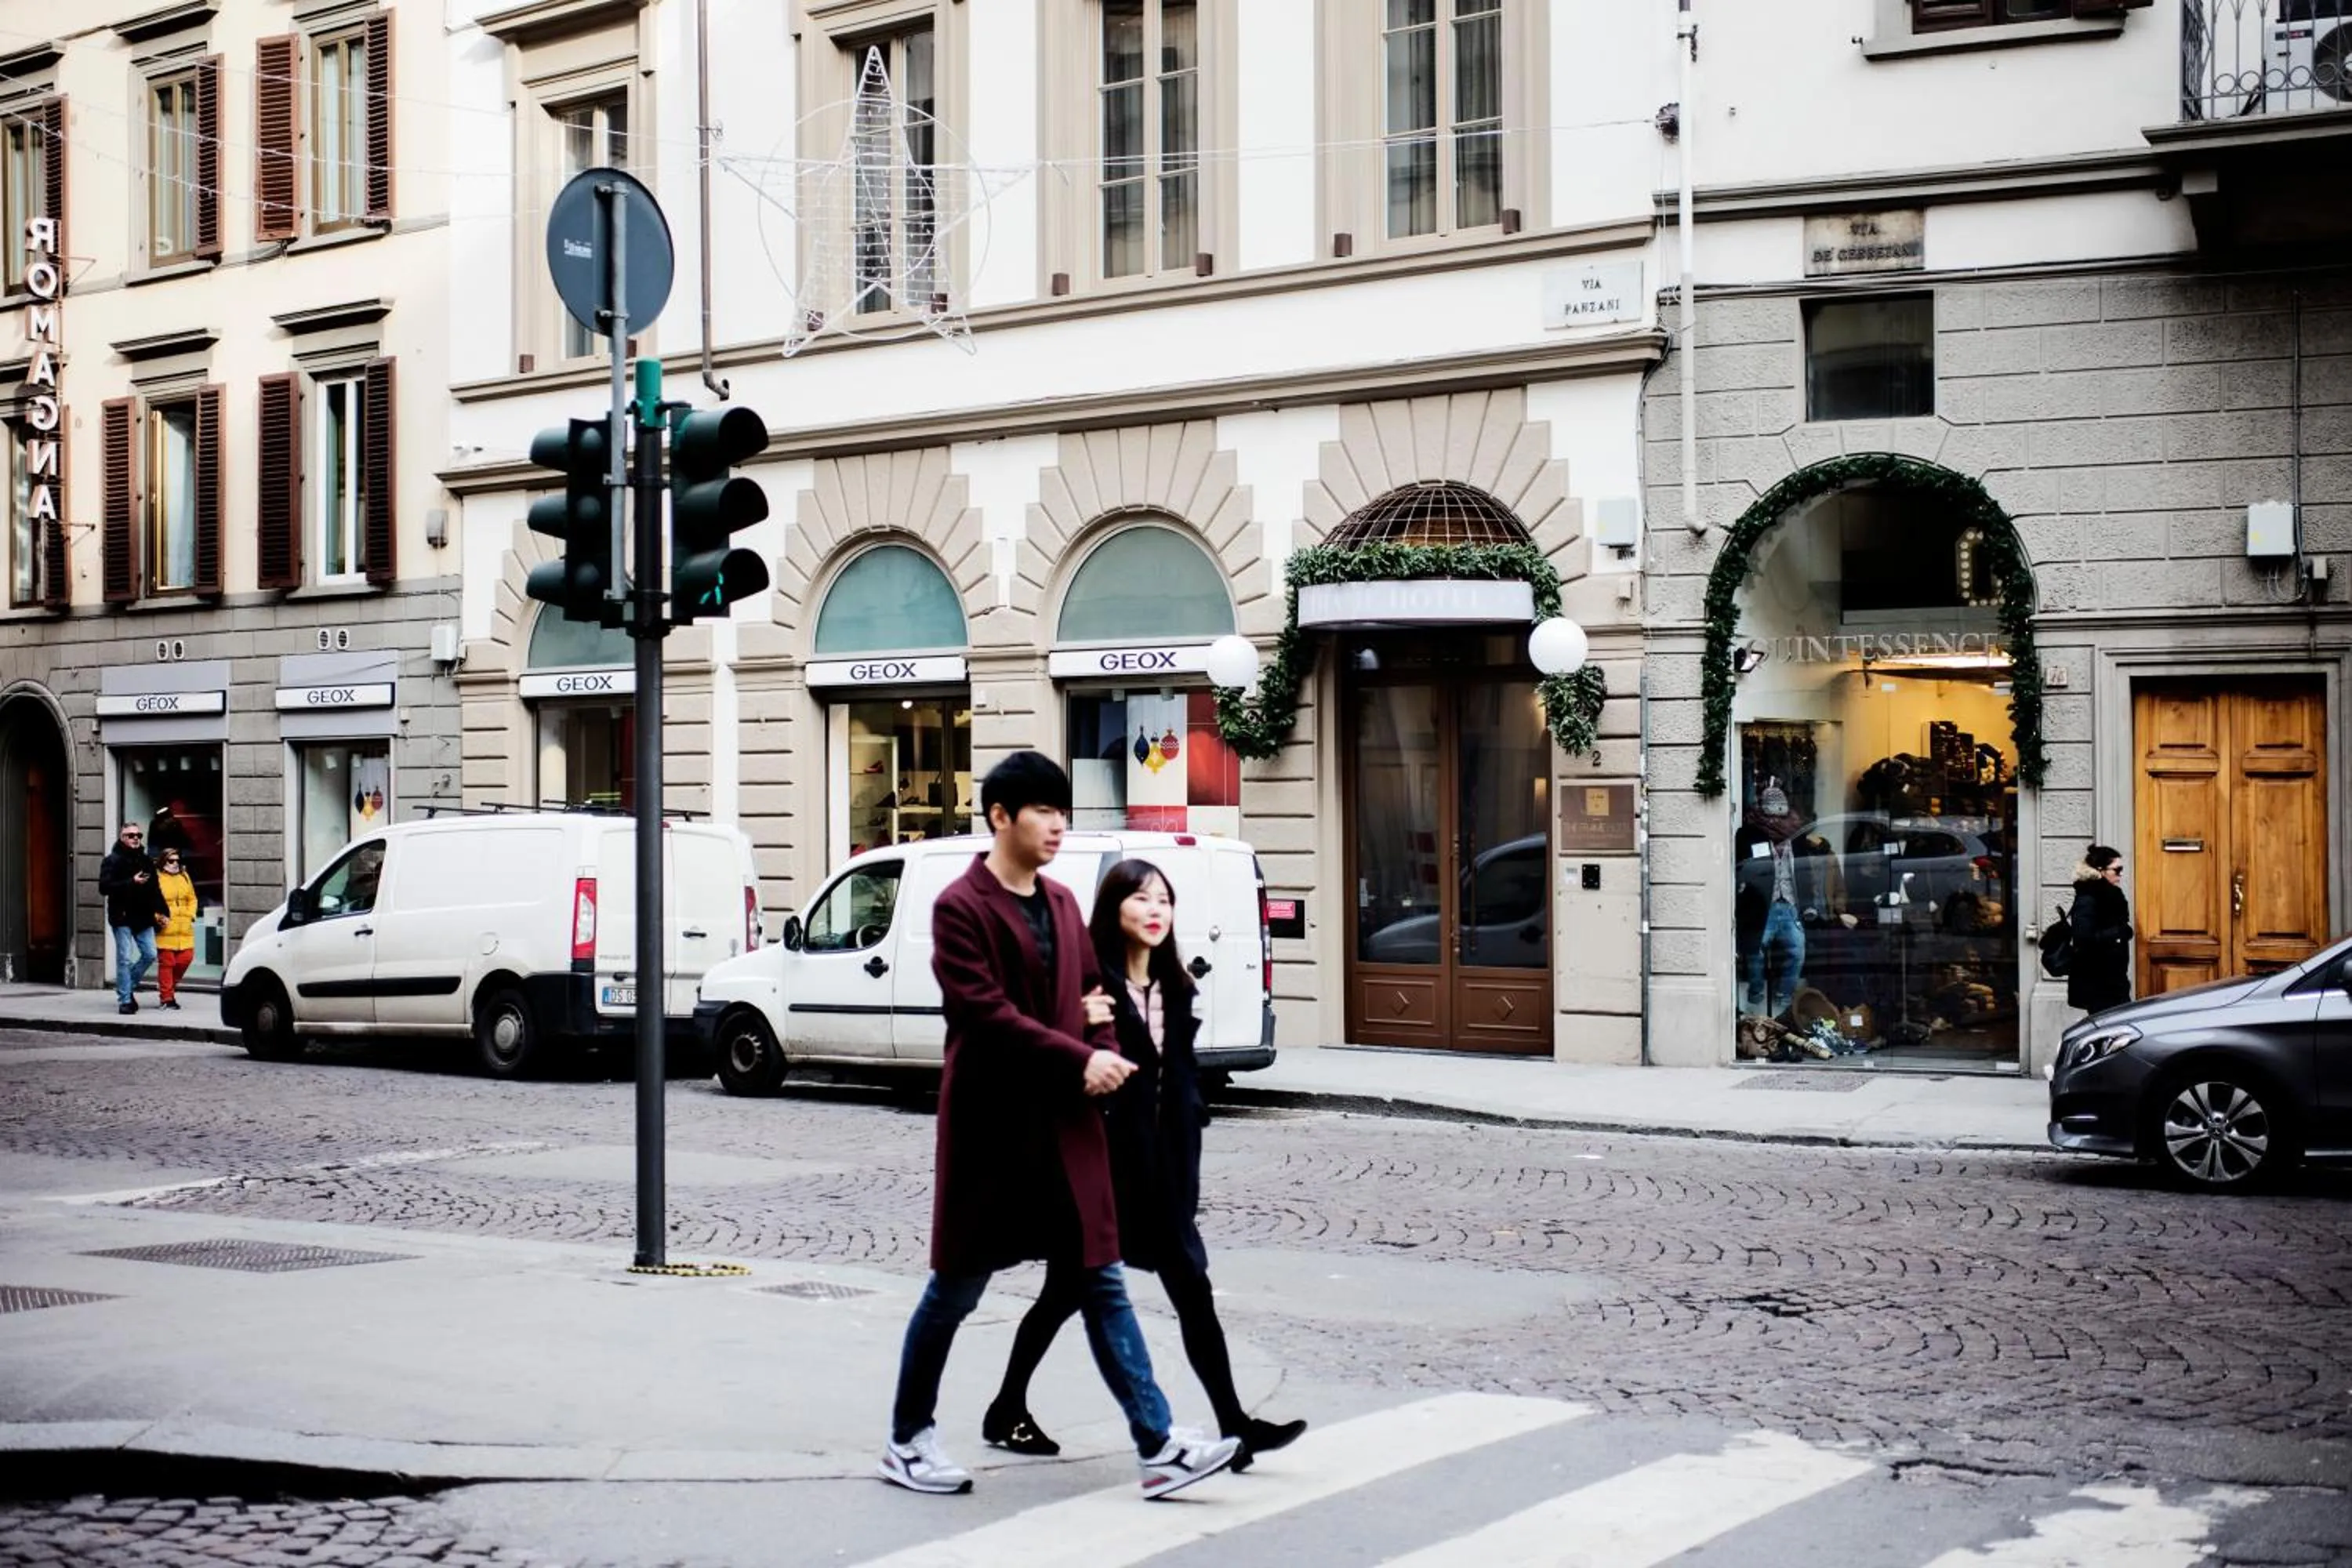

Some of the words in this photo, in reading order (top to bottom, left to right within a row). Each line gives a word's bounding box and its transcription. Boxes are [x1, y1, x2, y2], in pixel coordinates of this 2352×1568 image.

[1849, 222, 1880, 236] VIA
[1581, 278, 1602, 290] VIA
[1564, 299, 1620, 316] PANZANI
[1099, 652, 1177, 671] GEOX
[850, 662, 917, 681] GEOX
[556, 675, 613, 692] GEOX
[136, 697, 179, 711] GEOX
[307, 689, 355, 703] GEOX
[1592, 750, 1602, 767] 2
